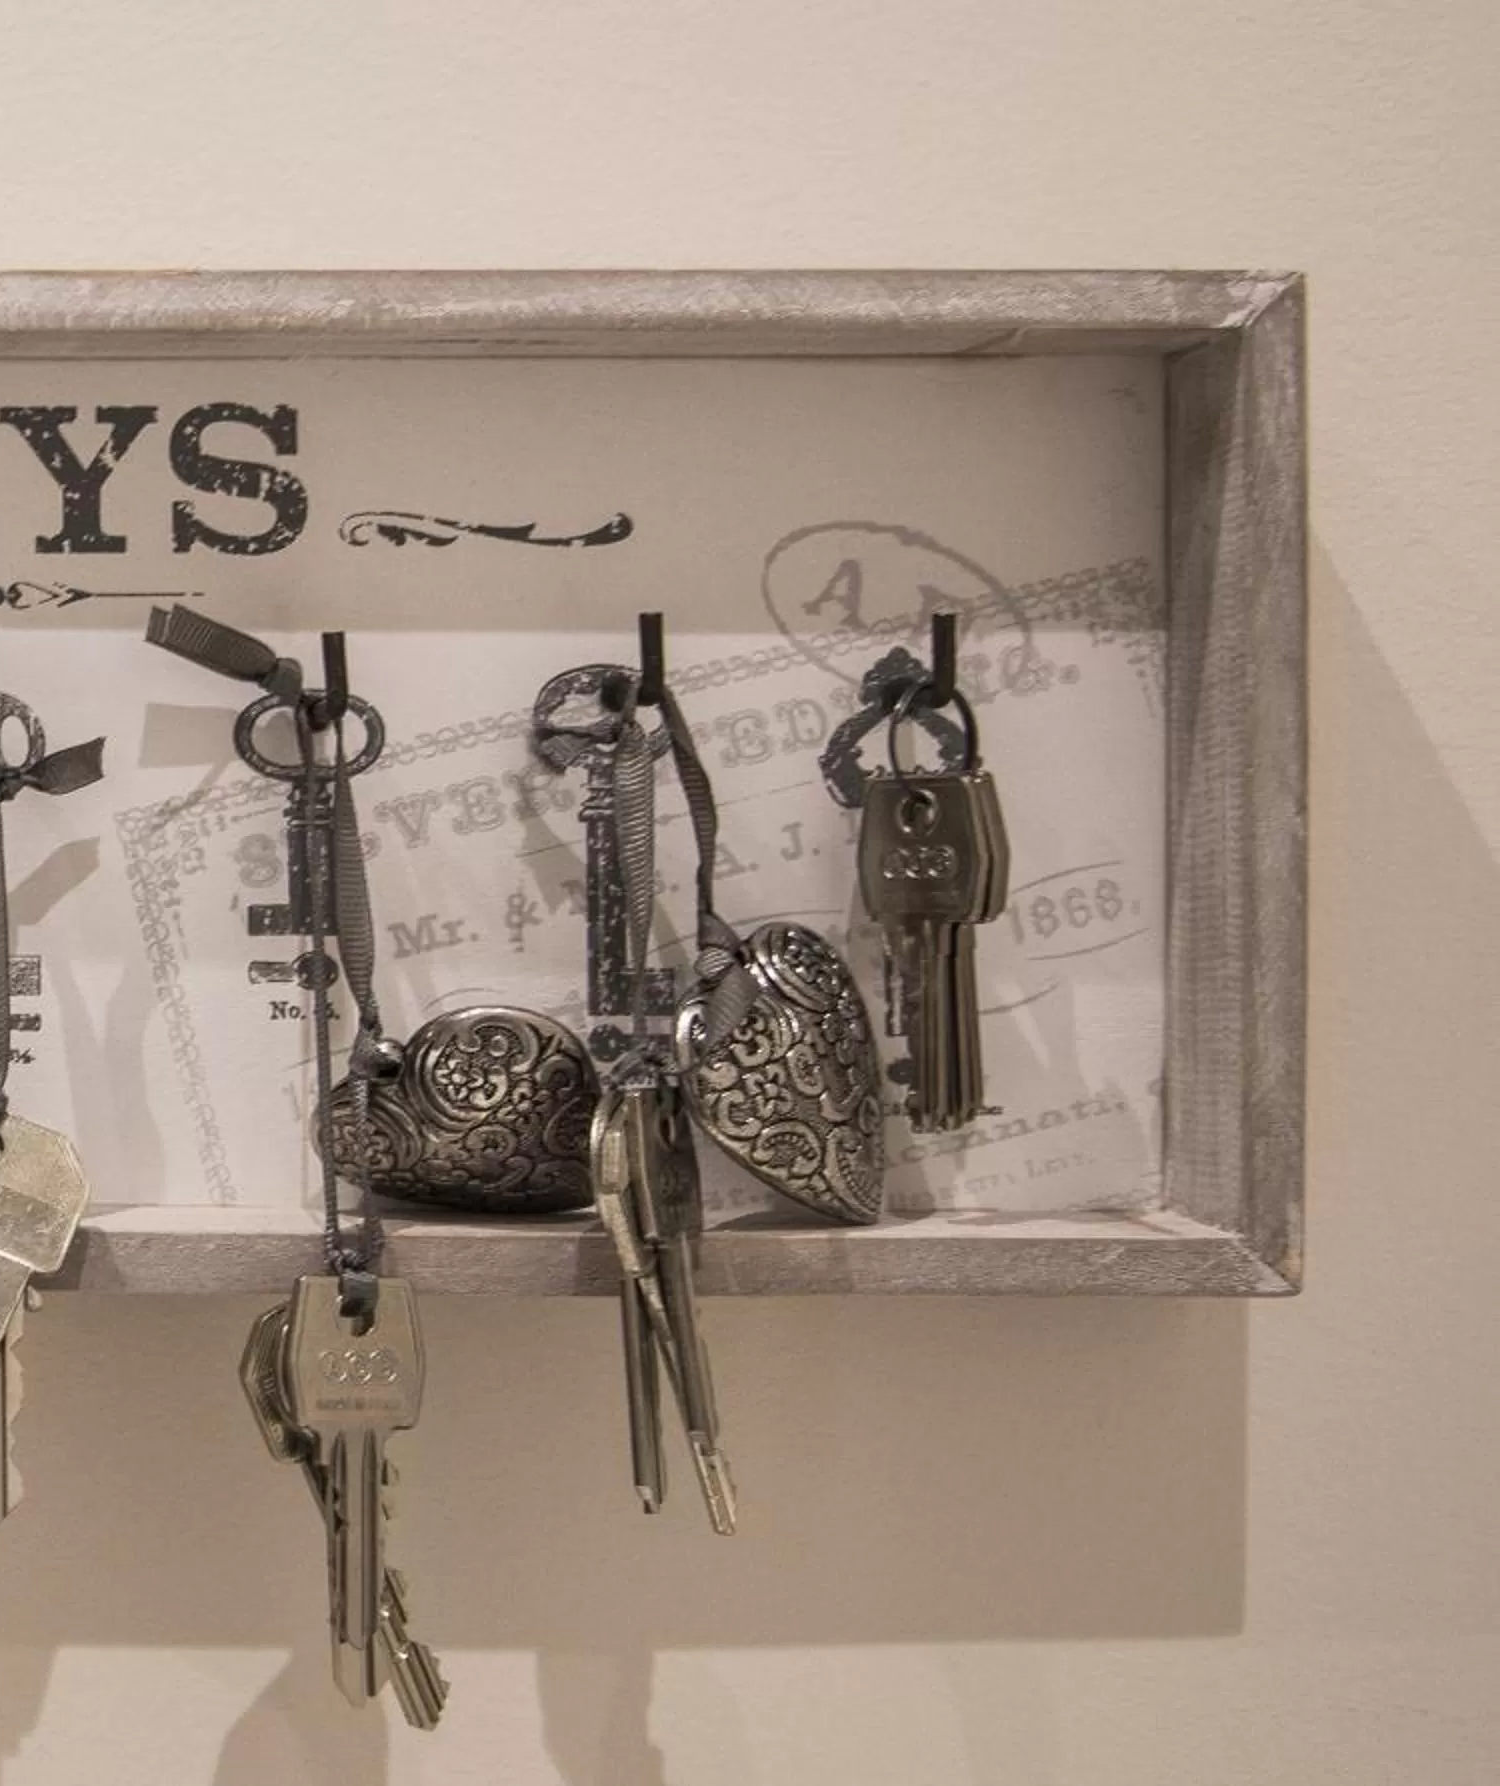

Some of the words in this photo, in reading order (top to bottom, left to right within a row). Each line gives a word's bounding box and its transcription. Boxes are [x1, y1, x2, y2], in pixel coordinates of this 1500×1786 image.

[387, 913, 480, 959] Mr.
[779, 823, 821, 862] J.
[267, 1001, 308, 1020] No.
